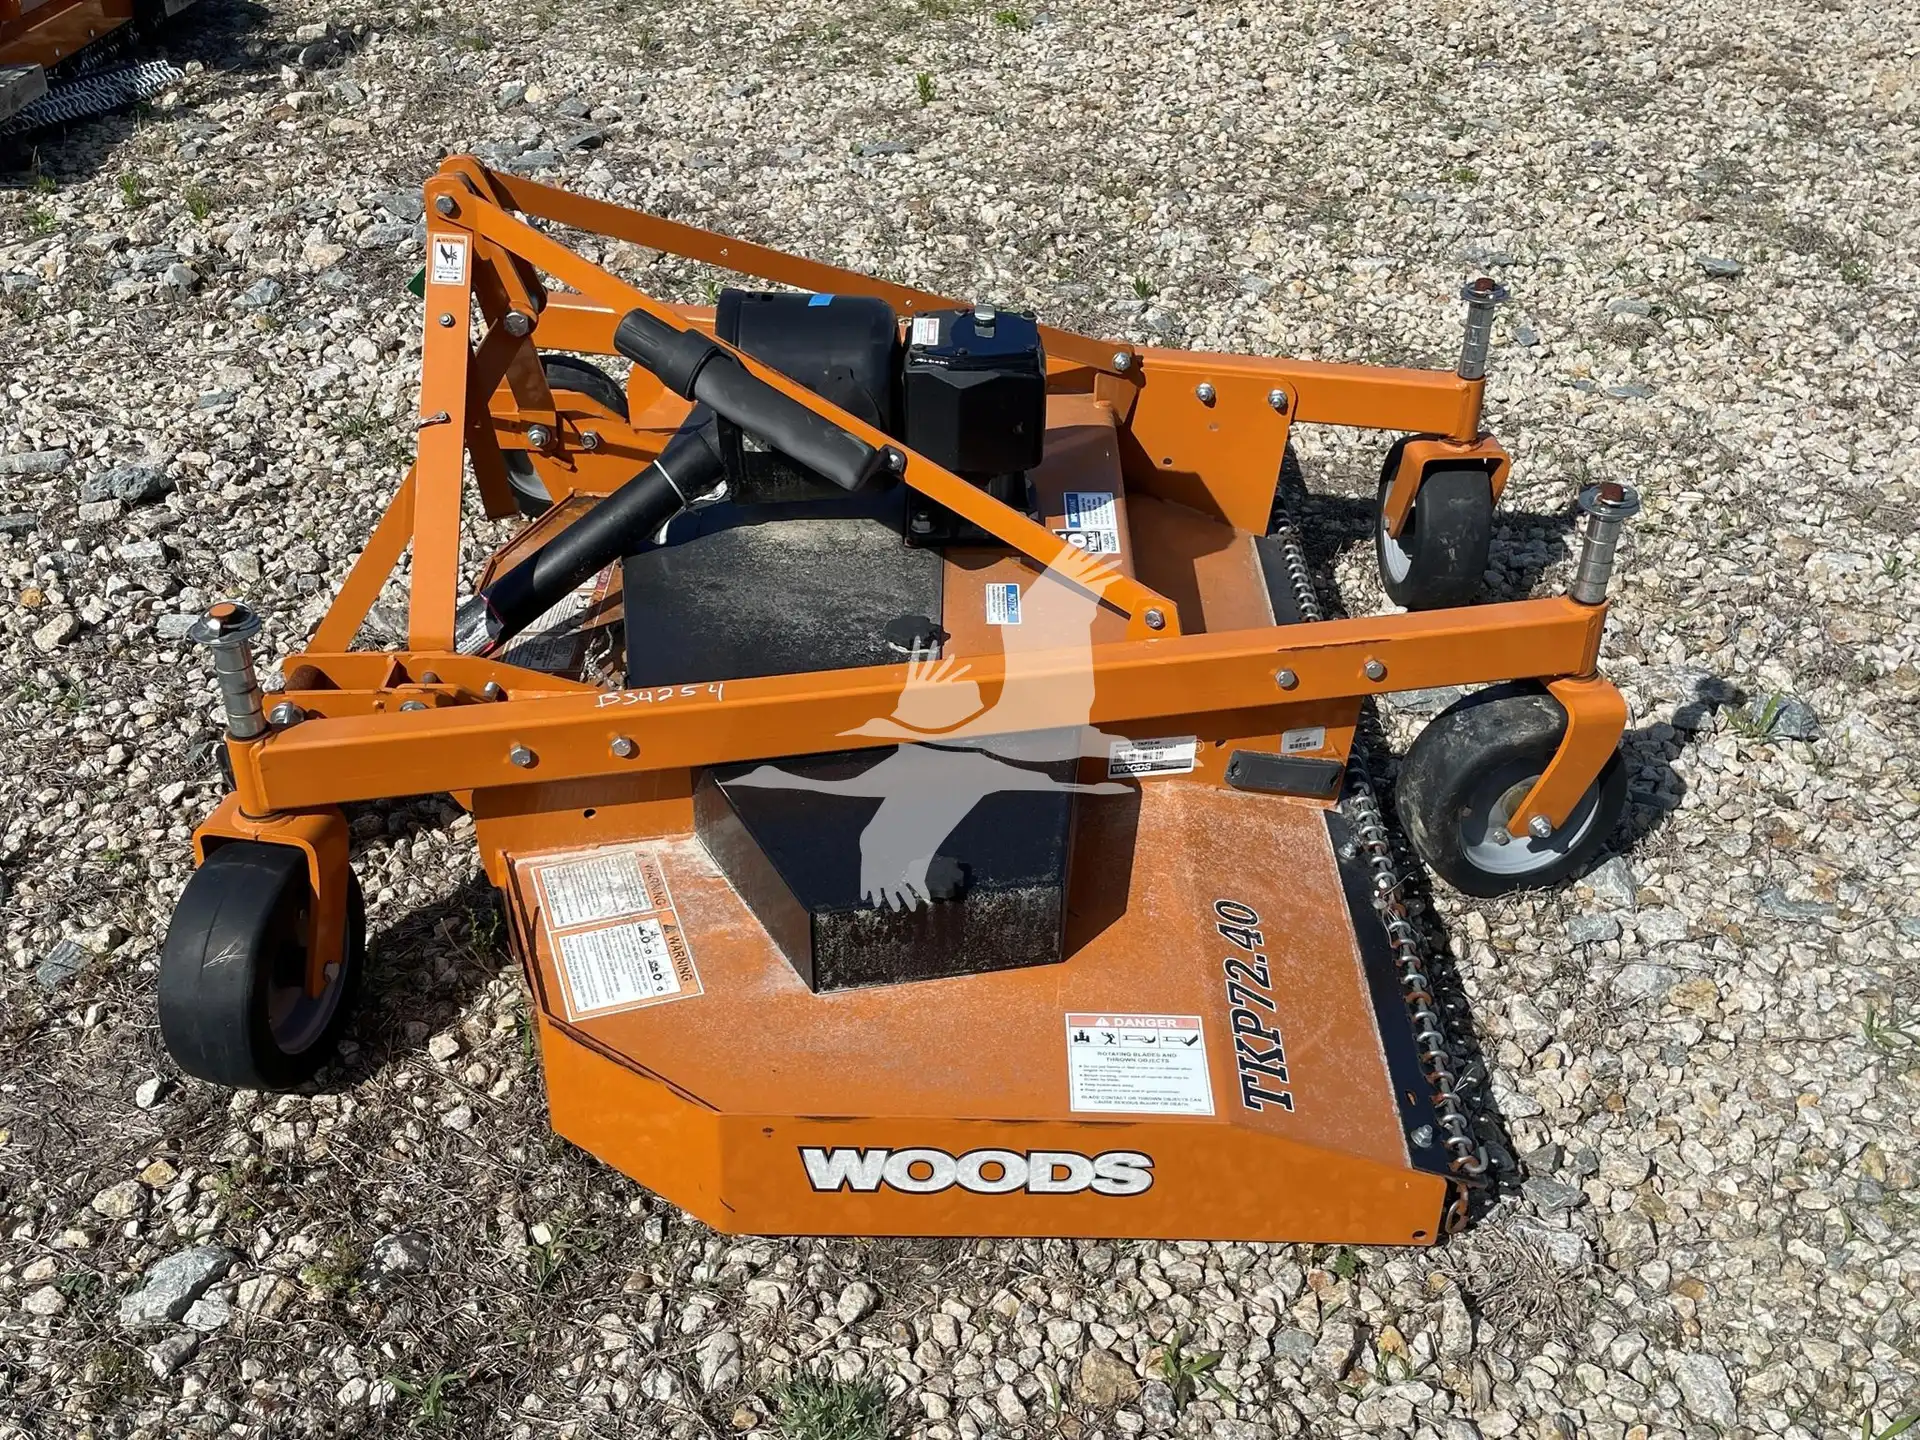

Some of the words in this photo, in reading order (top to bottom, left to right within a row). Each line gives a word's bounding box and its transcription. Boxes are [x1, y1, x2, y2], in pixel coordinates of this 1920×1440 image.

[1007, 592, 1018, 615] NOTICE
[644, 863, 668, 907] WARNING
[668, 935, 694, 983] WARNING
[1114, 1017, 1177, 1028] DANGER
[1214, 899, 1295, 1113] TKP72.40
